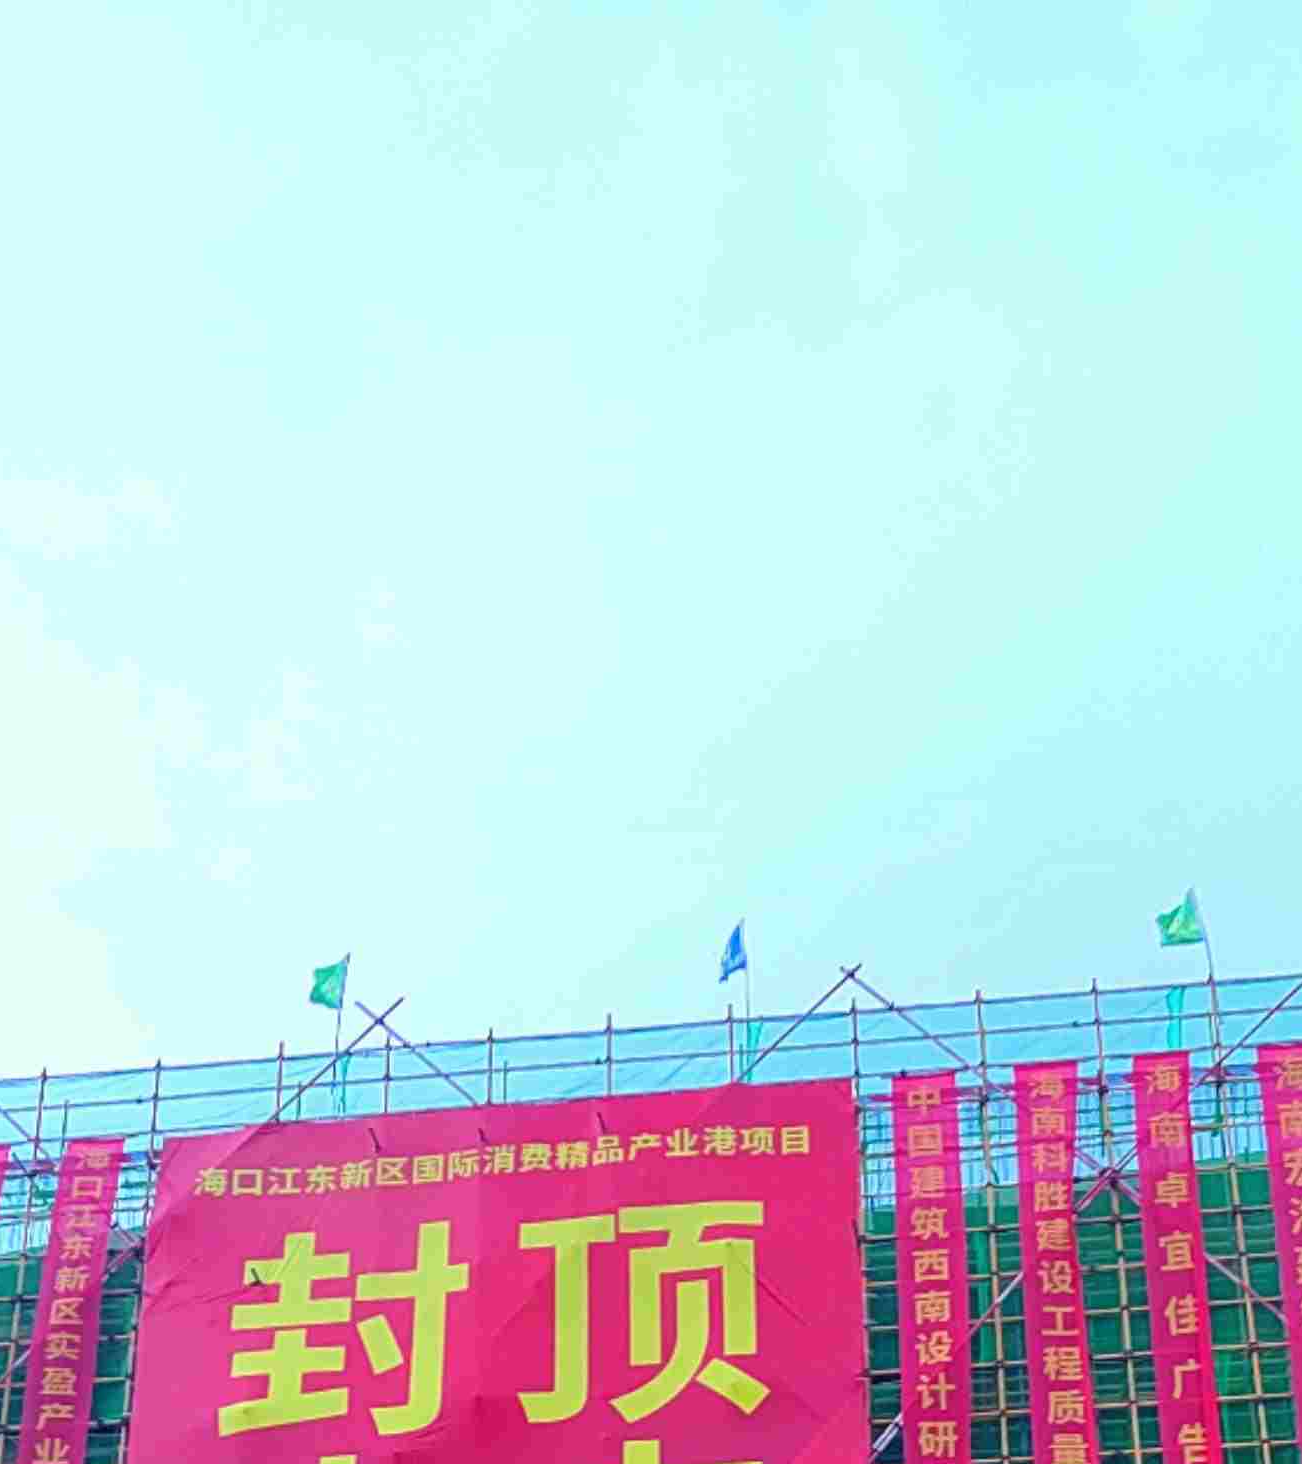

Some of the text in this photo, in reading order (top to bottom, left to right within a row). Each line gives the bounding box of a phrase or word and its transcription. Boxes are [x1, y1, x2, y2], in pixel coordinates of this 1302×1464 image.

[194, 1125, 812, 1198] 海口江东新区国际消费精品产业港项目
[218, 1200, 770, 1438] 封顶
